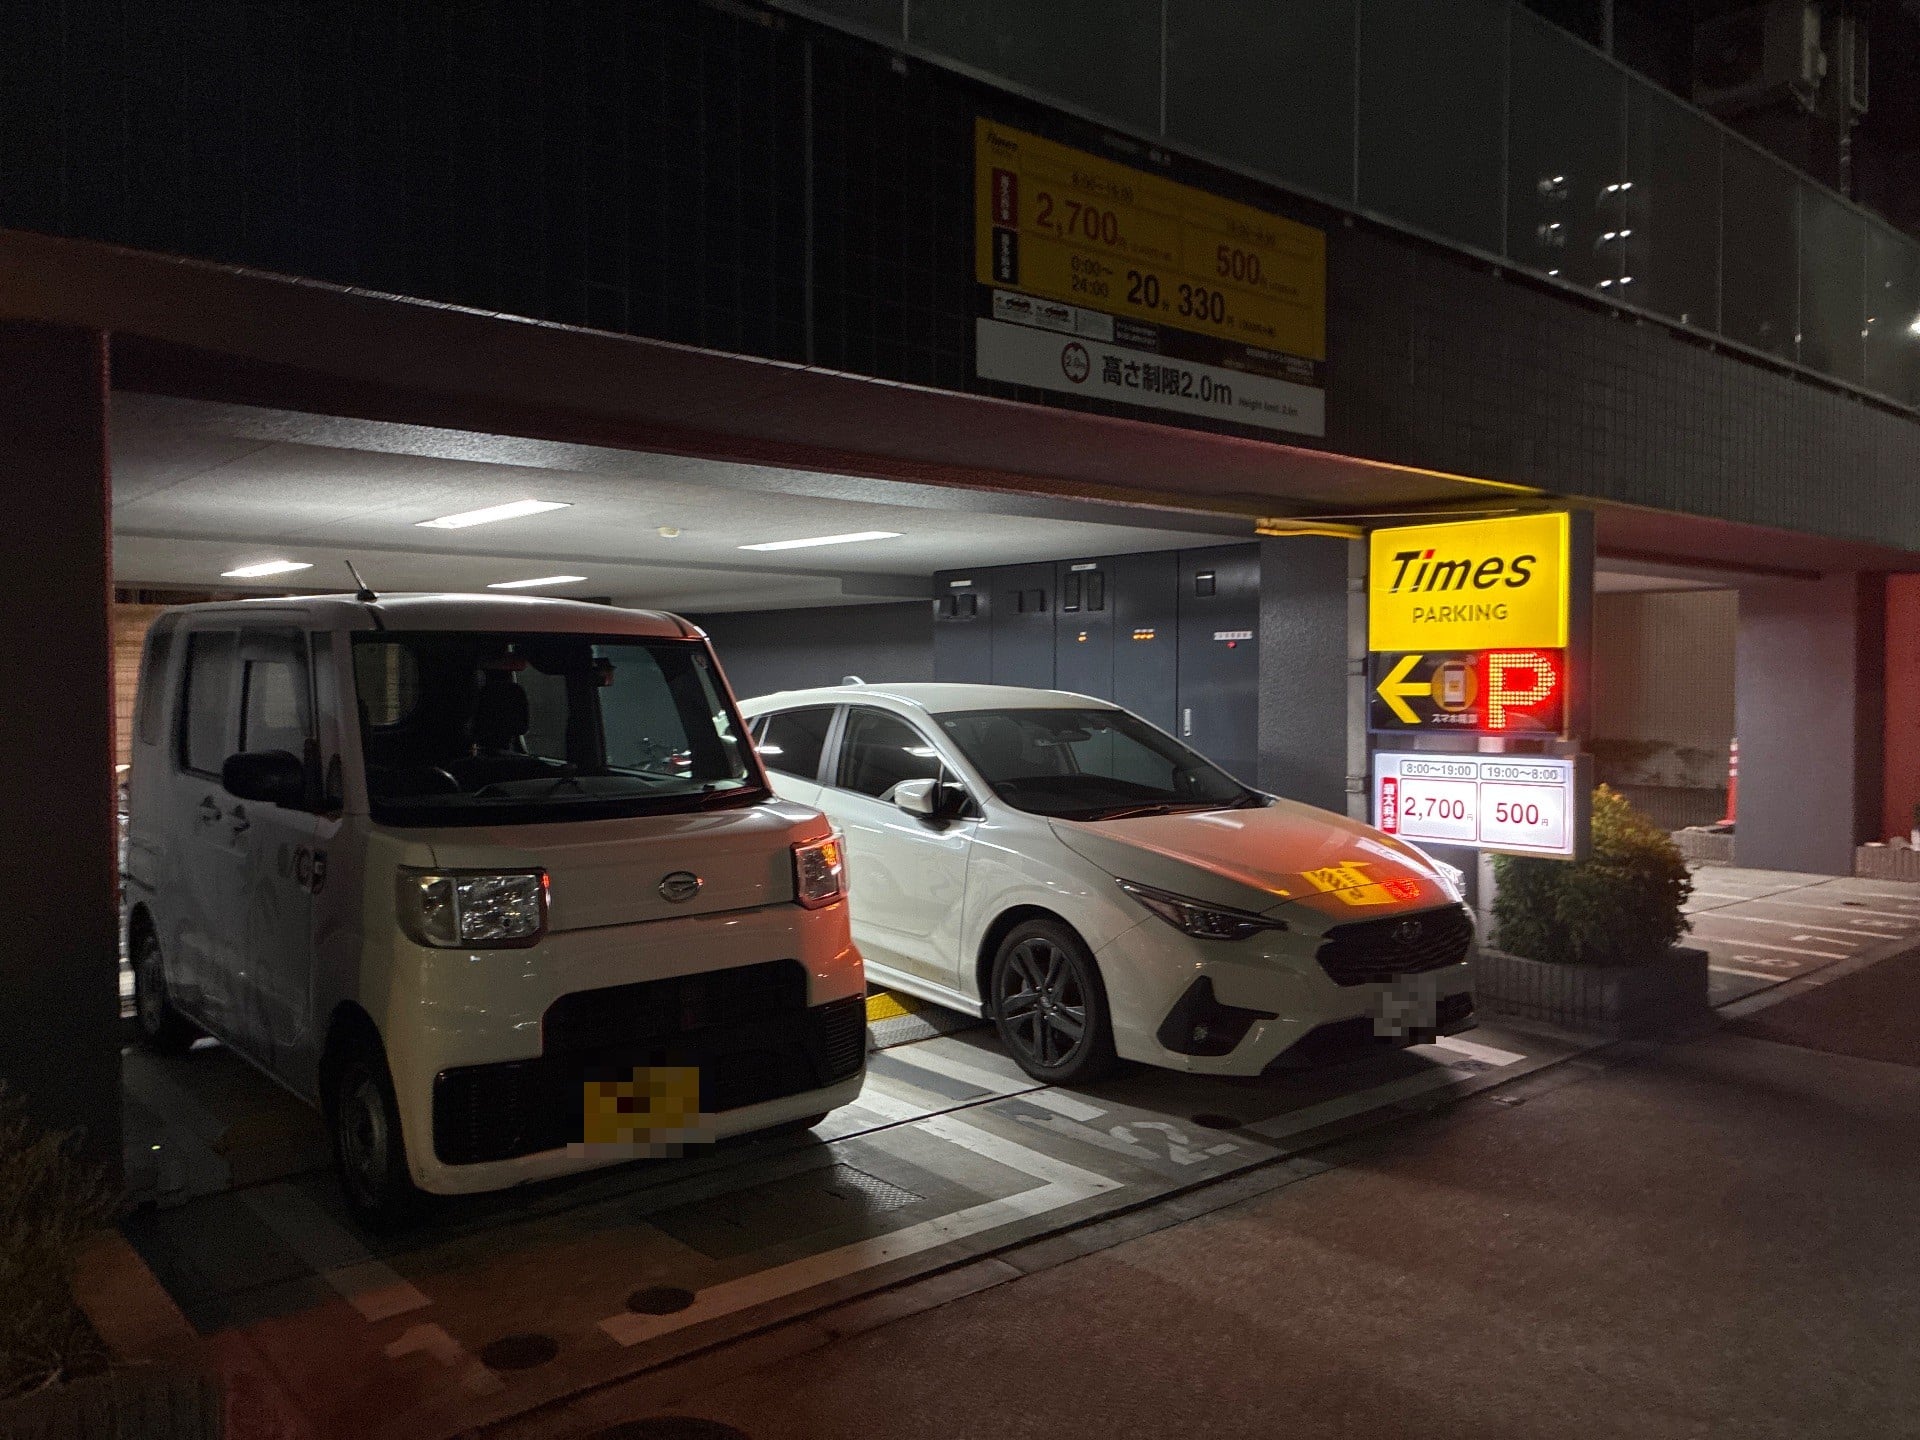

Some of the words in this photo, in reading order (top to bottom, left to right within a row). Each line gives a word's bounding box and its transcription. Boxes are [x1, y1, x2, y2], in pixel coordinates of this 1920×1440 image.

[1102, 354, 1233, 406] 高さ制限2.0m
[1389, 549, 1536, 594] Times
[1412, 603, 1509, 624] PARKING
[1488, 652, 1556, 729] P
